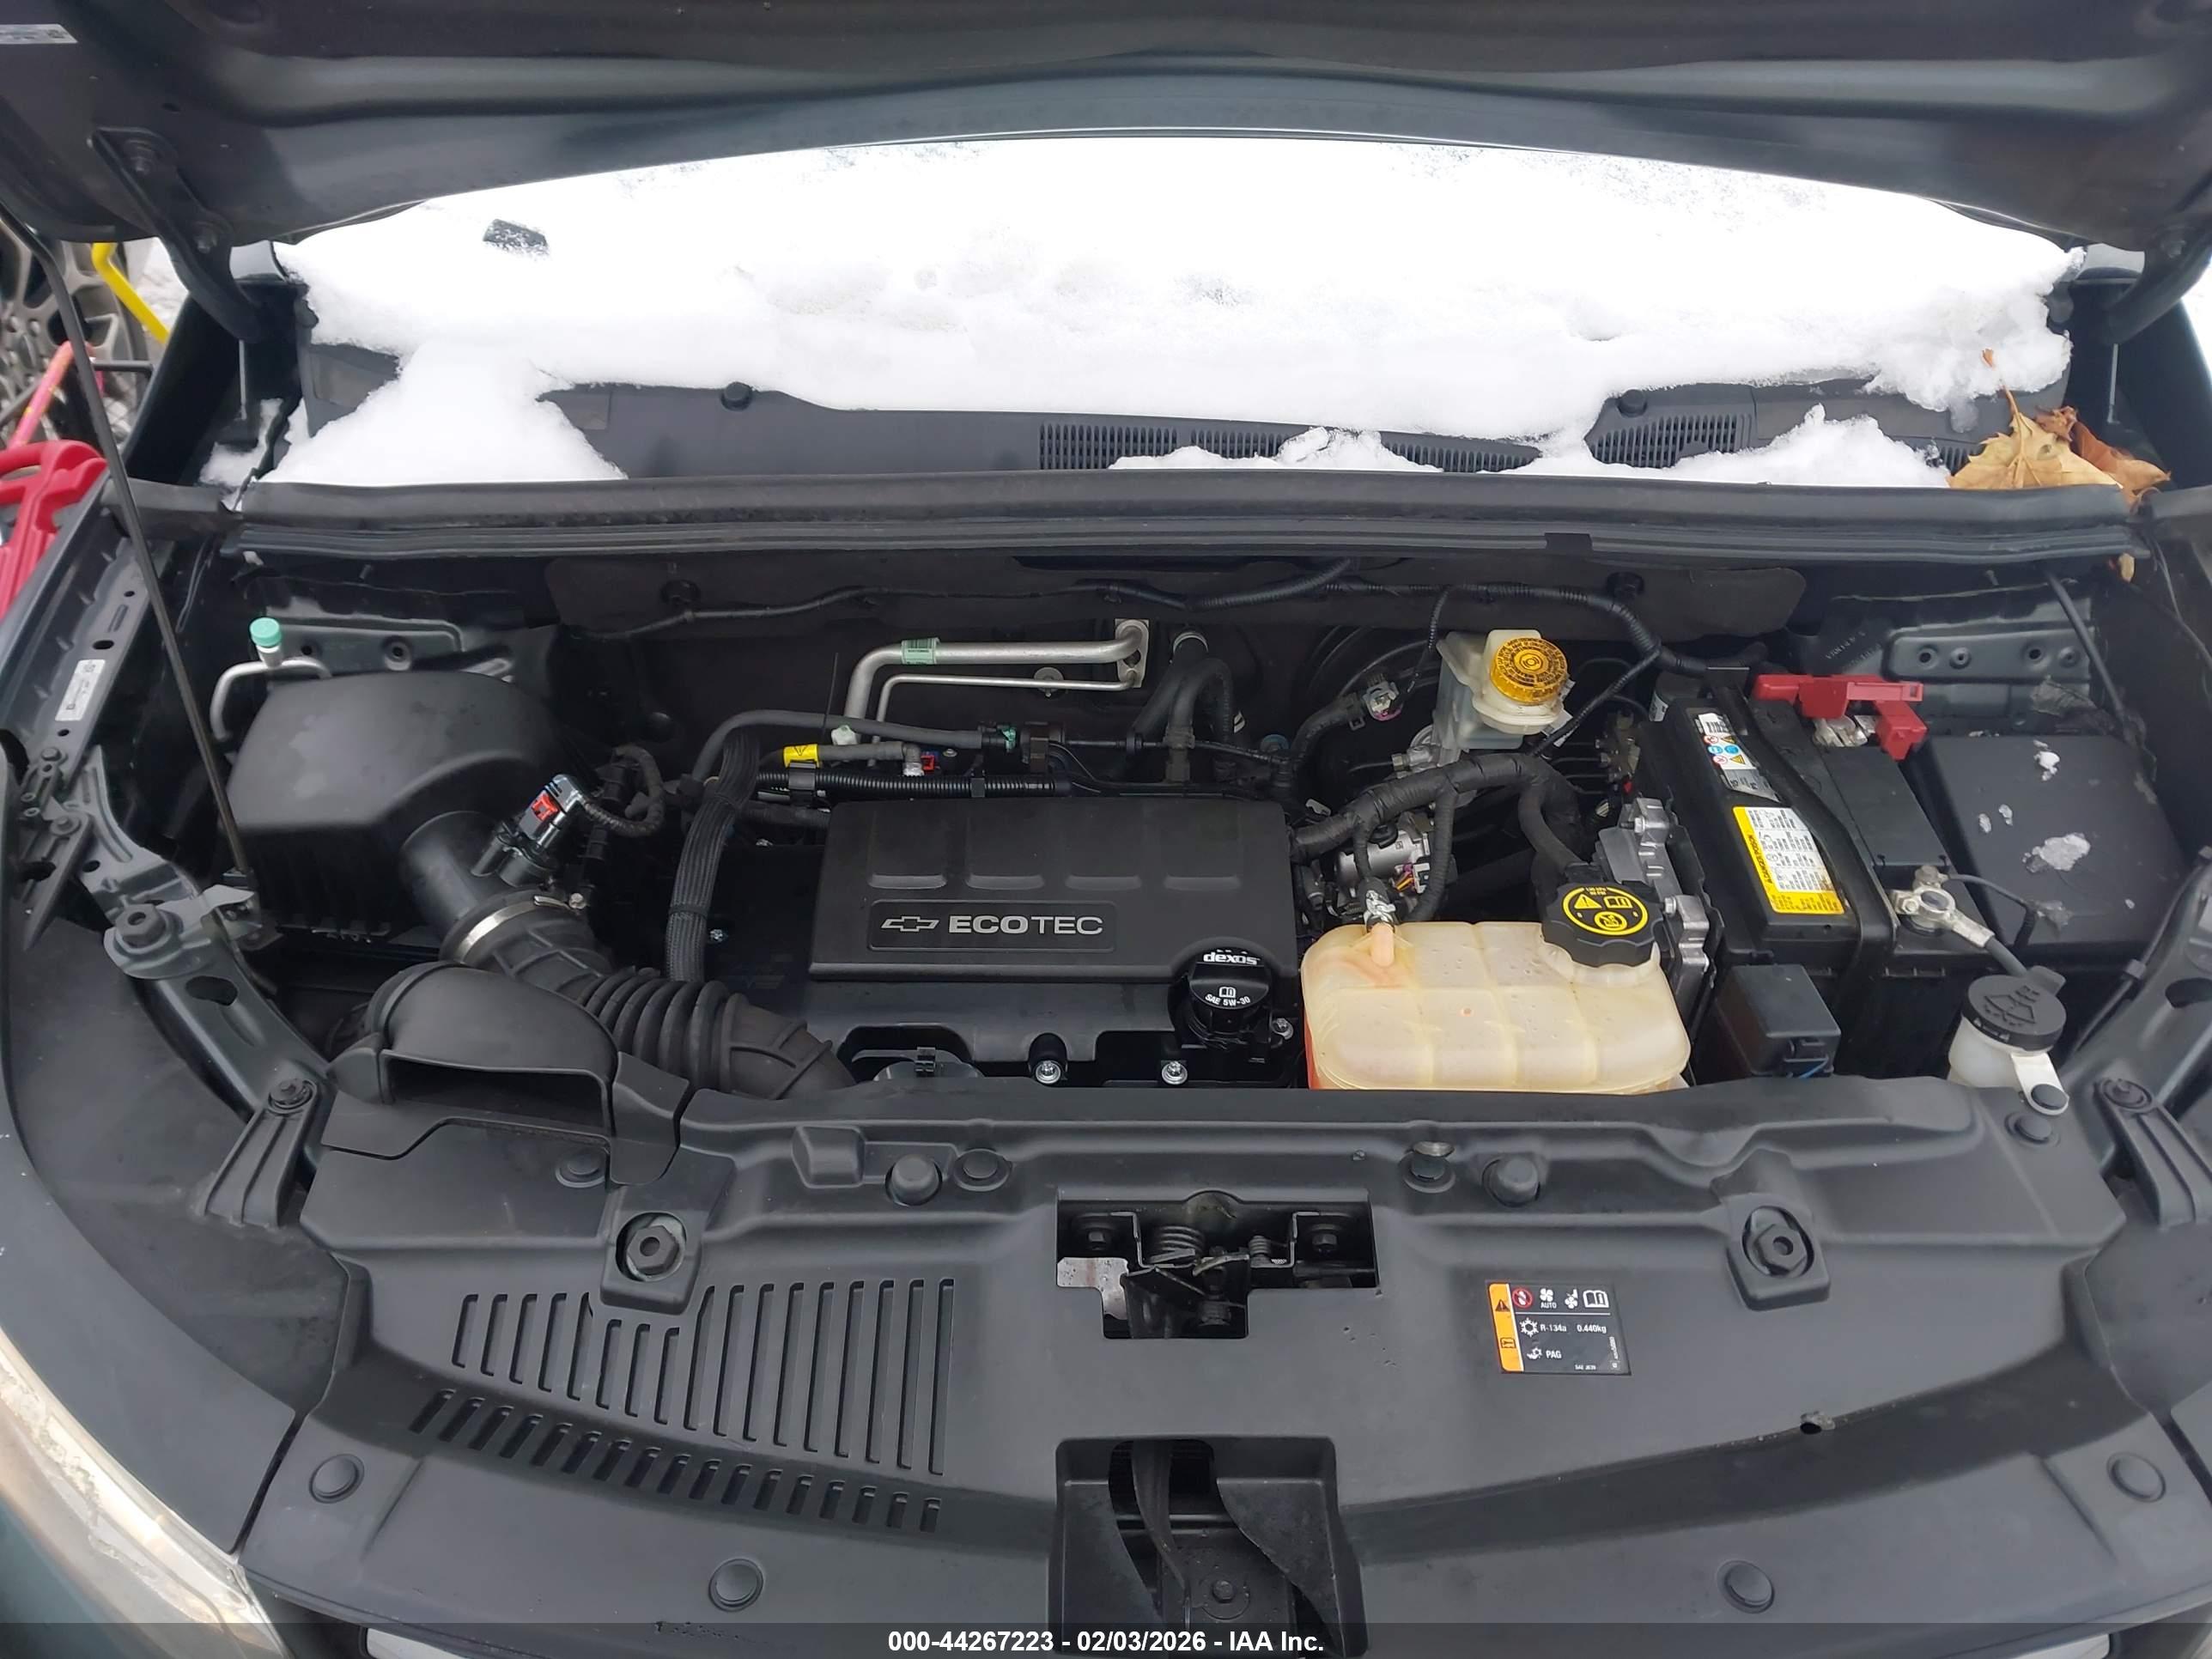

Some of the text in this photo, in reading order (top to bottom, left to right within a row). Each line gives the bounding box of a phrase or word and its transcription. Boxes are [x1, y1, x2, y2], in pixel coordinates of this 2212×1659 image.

[949, 915, 1103, 935] ECOTEC
[1203, 951, 1258, 965] dexos
[1205, 994, 1251, 1006] SAE 5W-30
[1577, 1324, 1607, 1334] 0.440kg
[1546, 1351, 1562, 1359] PAG
